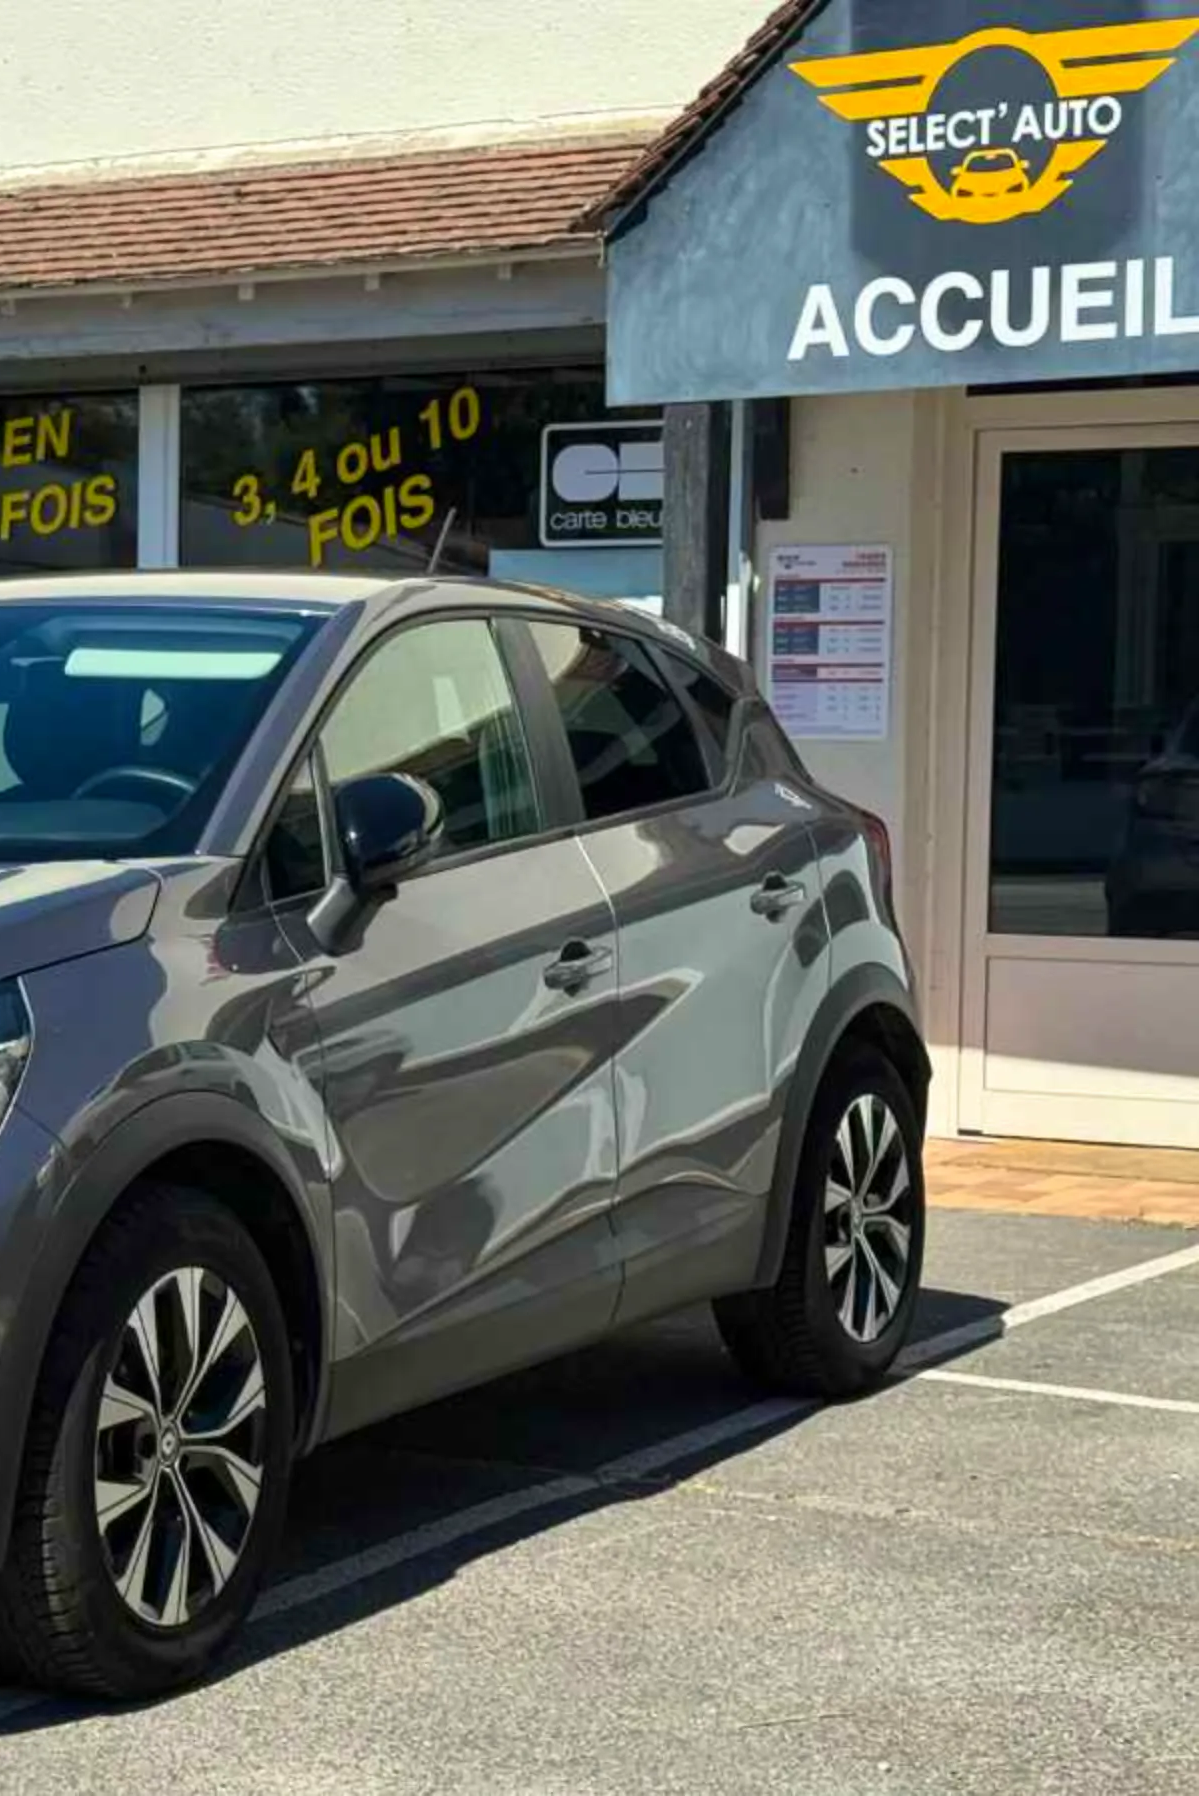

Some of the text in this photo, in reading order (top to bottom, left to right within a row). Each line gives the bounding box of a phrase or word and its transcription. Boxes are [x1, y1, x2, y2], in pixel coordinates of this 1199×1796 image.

[1012, 95, 1122, 142] AUTO
[787, 256, 1199, 361] ACCUEIL
[2, 408, 74, 467] EN
[291, 449, 321, 499] 4
[336, 426, 402, 484] ou
[418, 386, 481, 450] 10
[0, 475, 117, 541] FOIS
[307, 473, 435, 568] FOIS
[550, 509, 664, 532] carte bleu
